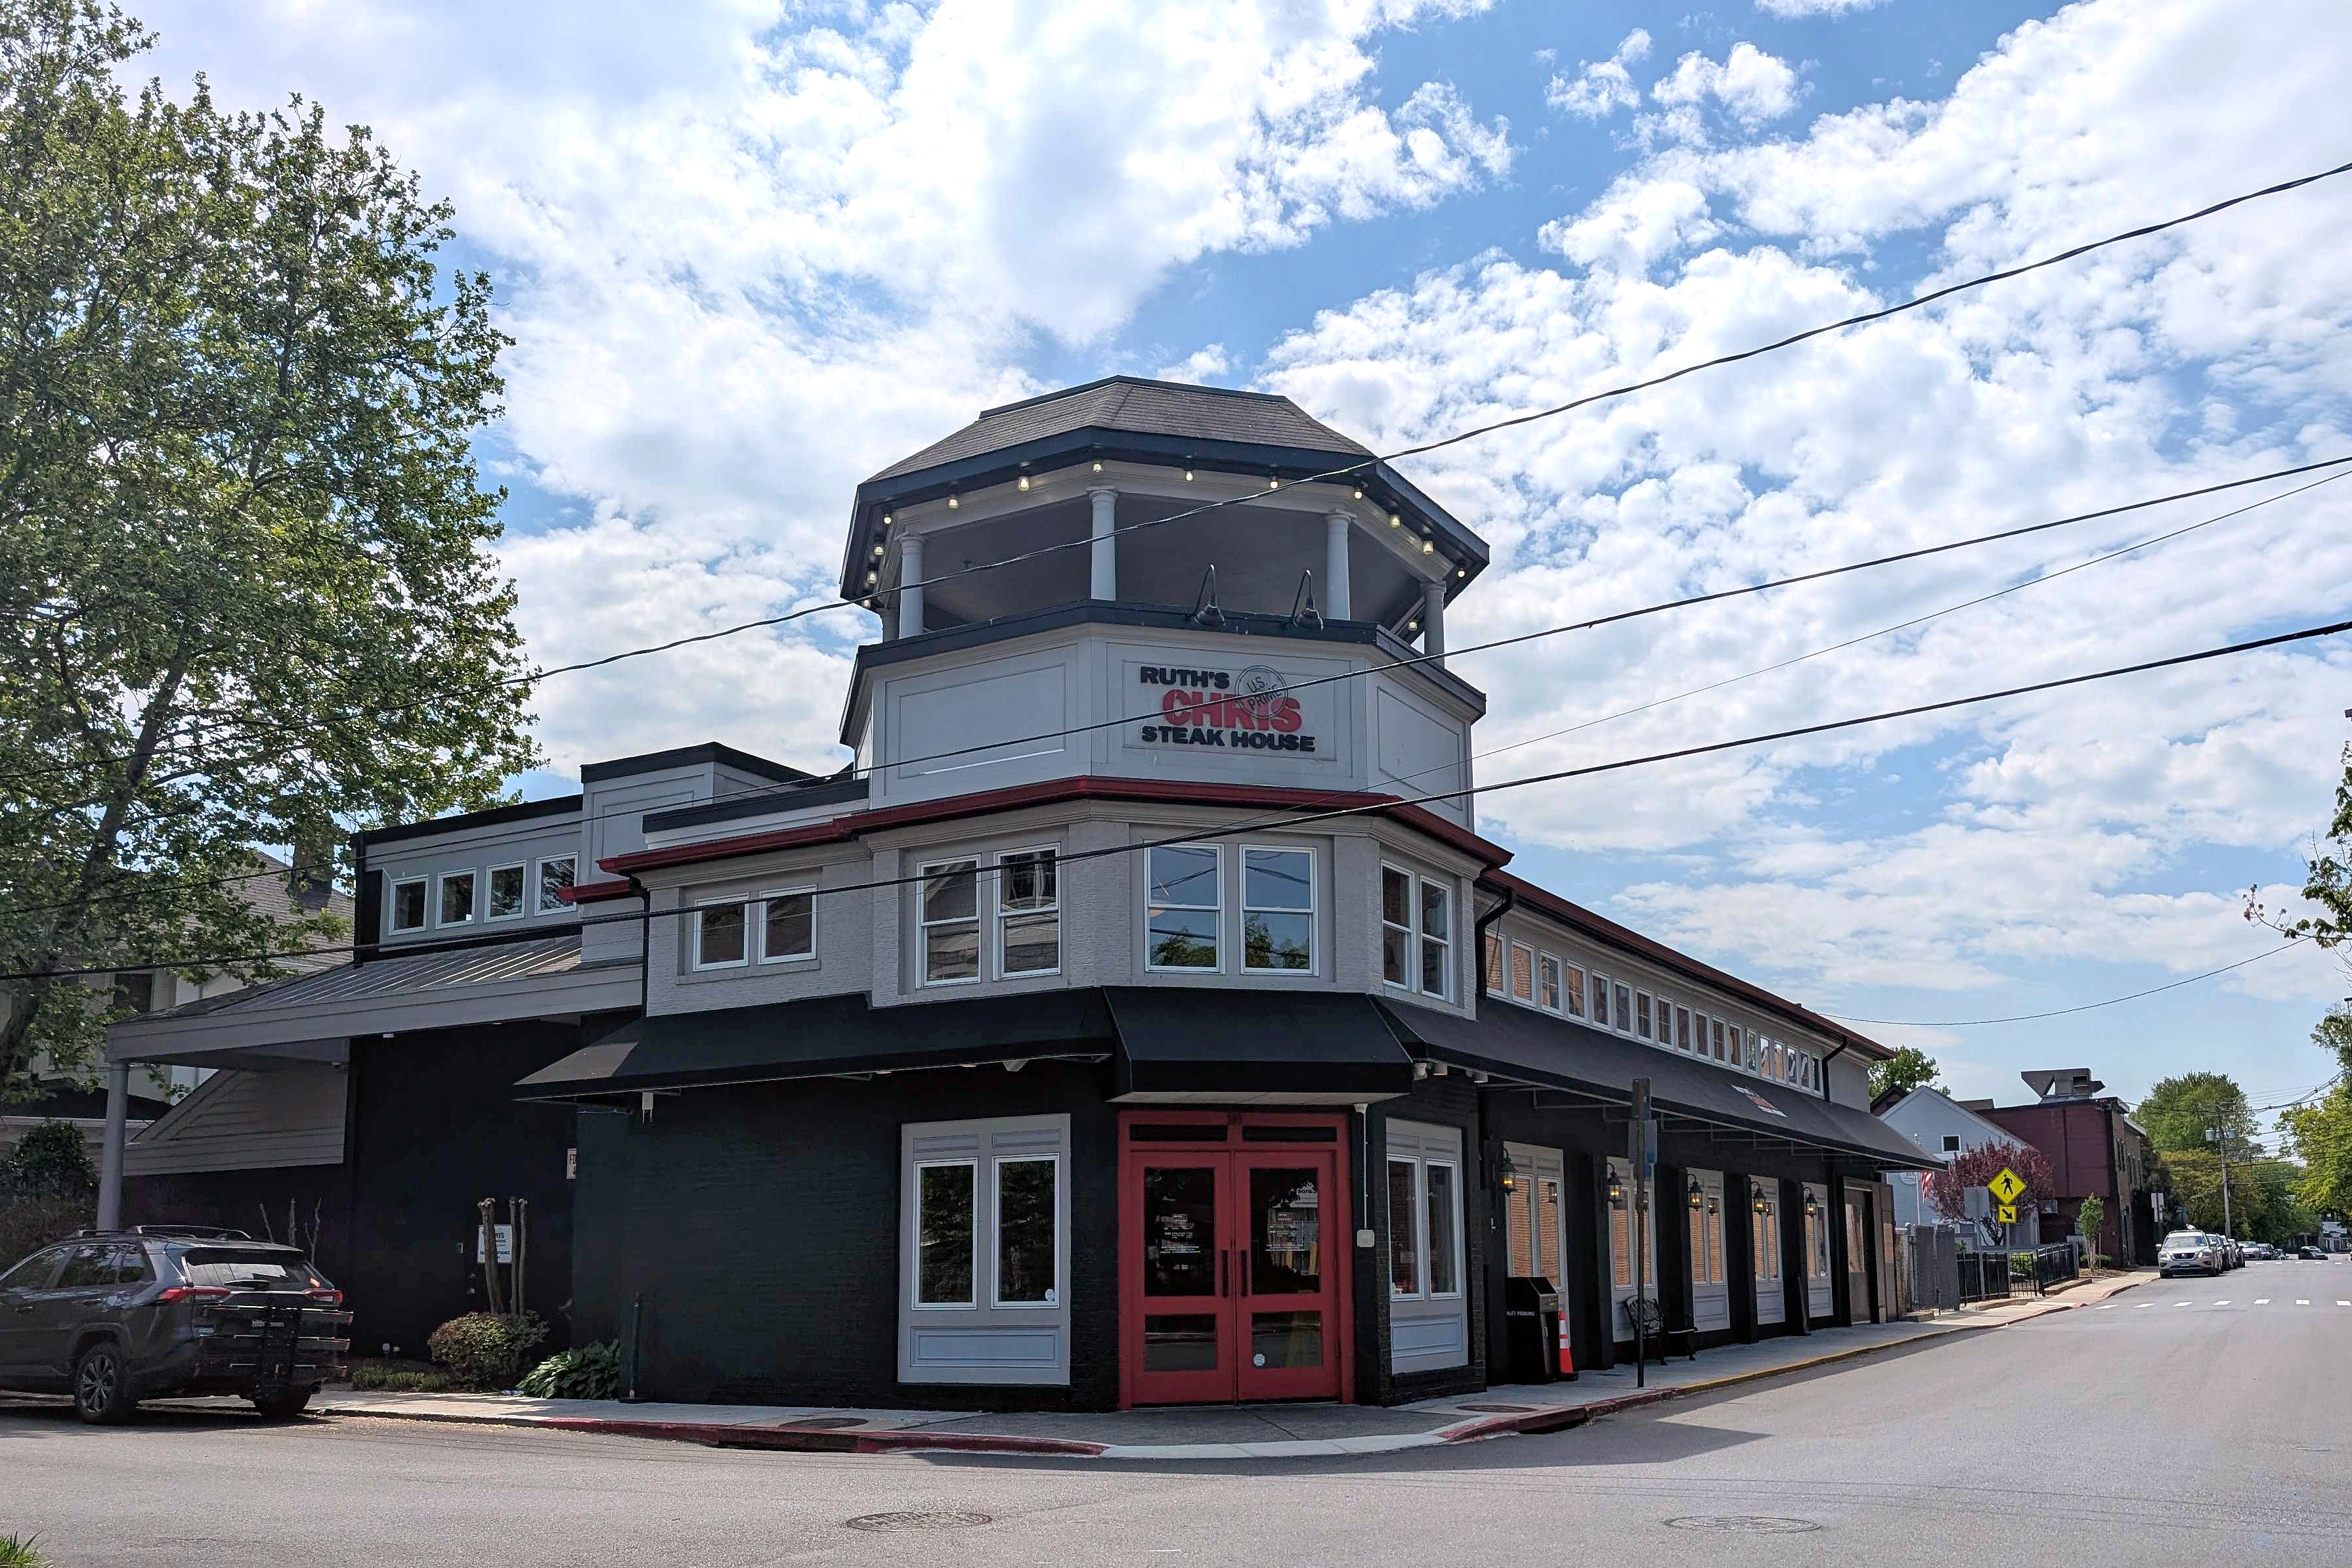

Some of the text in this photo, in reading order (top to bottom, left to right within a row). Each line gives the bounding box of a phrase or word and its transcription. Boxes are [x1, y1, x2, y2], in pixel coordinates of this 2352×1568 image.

[1141, 666, 1230, 689] RUTH'S
[1162, 689, 1302, 732] CHRIS
[1141, 726, 1315, 752] STEAK HOUSE
